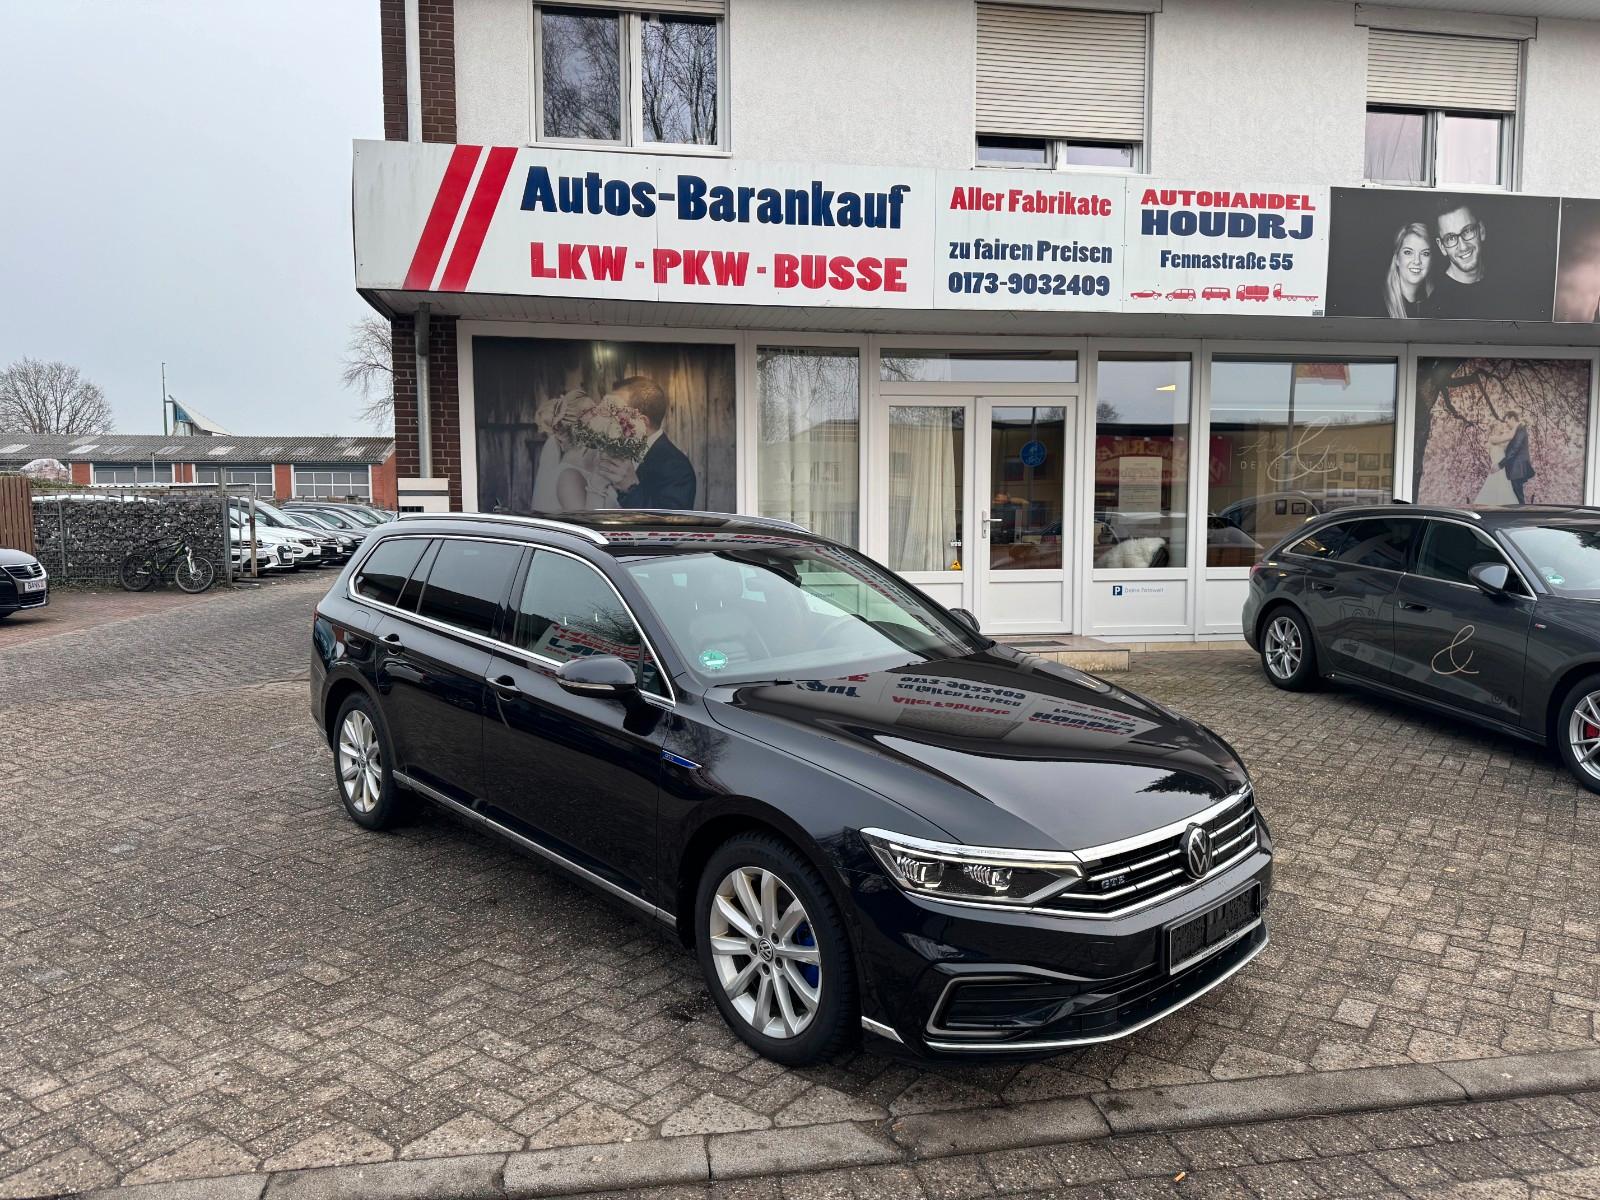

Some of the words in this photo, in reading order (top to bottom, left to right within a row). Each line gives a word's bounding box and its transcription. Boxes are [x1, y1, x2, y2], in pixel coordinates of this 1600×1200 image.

[520, 166, 911, 229] Autos-Barankauf
[950, 186, 1005, 213] Aller
[1008, 189, 1112, 217] Fabrikate
[1140, 188, 1316, 211] AUTOHANDEL
[1140, 209, 1315, 240] HOUDRJ
[948, 242, 971, 261] zu
[973, 238, 1033, 262] fairen
[1036, 240, 1113, 264] Preisen
[1160, 249, 1268, 271] Fennastraße
[1269, 253, 1294, 271] 55
[530, 242, 628, 282] LKW
[653, 248, 750, 288] PKW
[774, 254, 908, 293] BUSSE
[948, 271, 1111, 297] 0173-9032409
